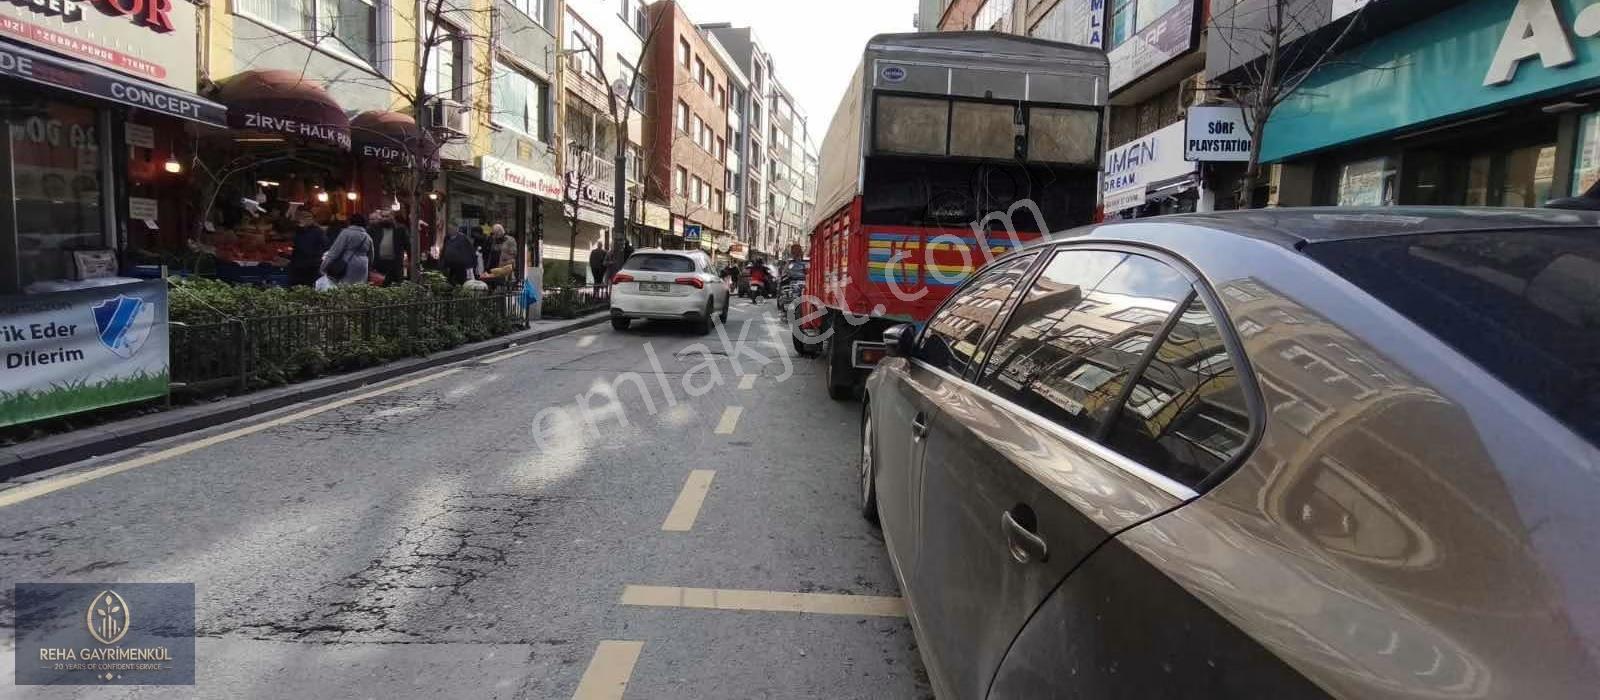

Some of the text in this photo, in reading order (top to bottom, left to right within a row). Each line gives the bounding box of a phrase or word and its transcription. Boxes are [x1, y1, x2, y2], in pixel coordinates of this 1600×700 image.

[111, 82, 201, 118] CONCEPT
[244, 112, 296, 133] ZİRVE
[300, 123, 335, 141] HALK
[1208, 119, 1235, 135] SÖRF
[363, 145, 399, 160] EYÜP
[1189, 139, 1251, 153] PLAYSTATİO
[30, 322, 78, 340] Eder
[6, 347, 85, 370] Dilerim
